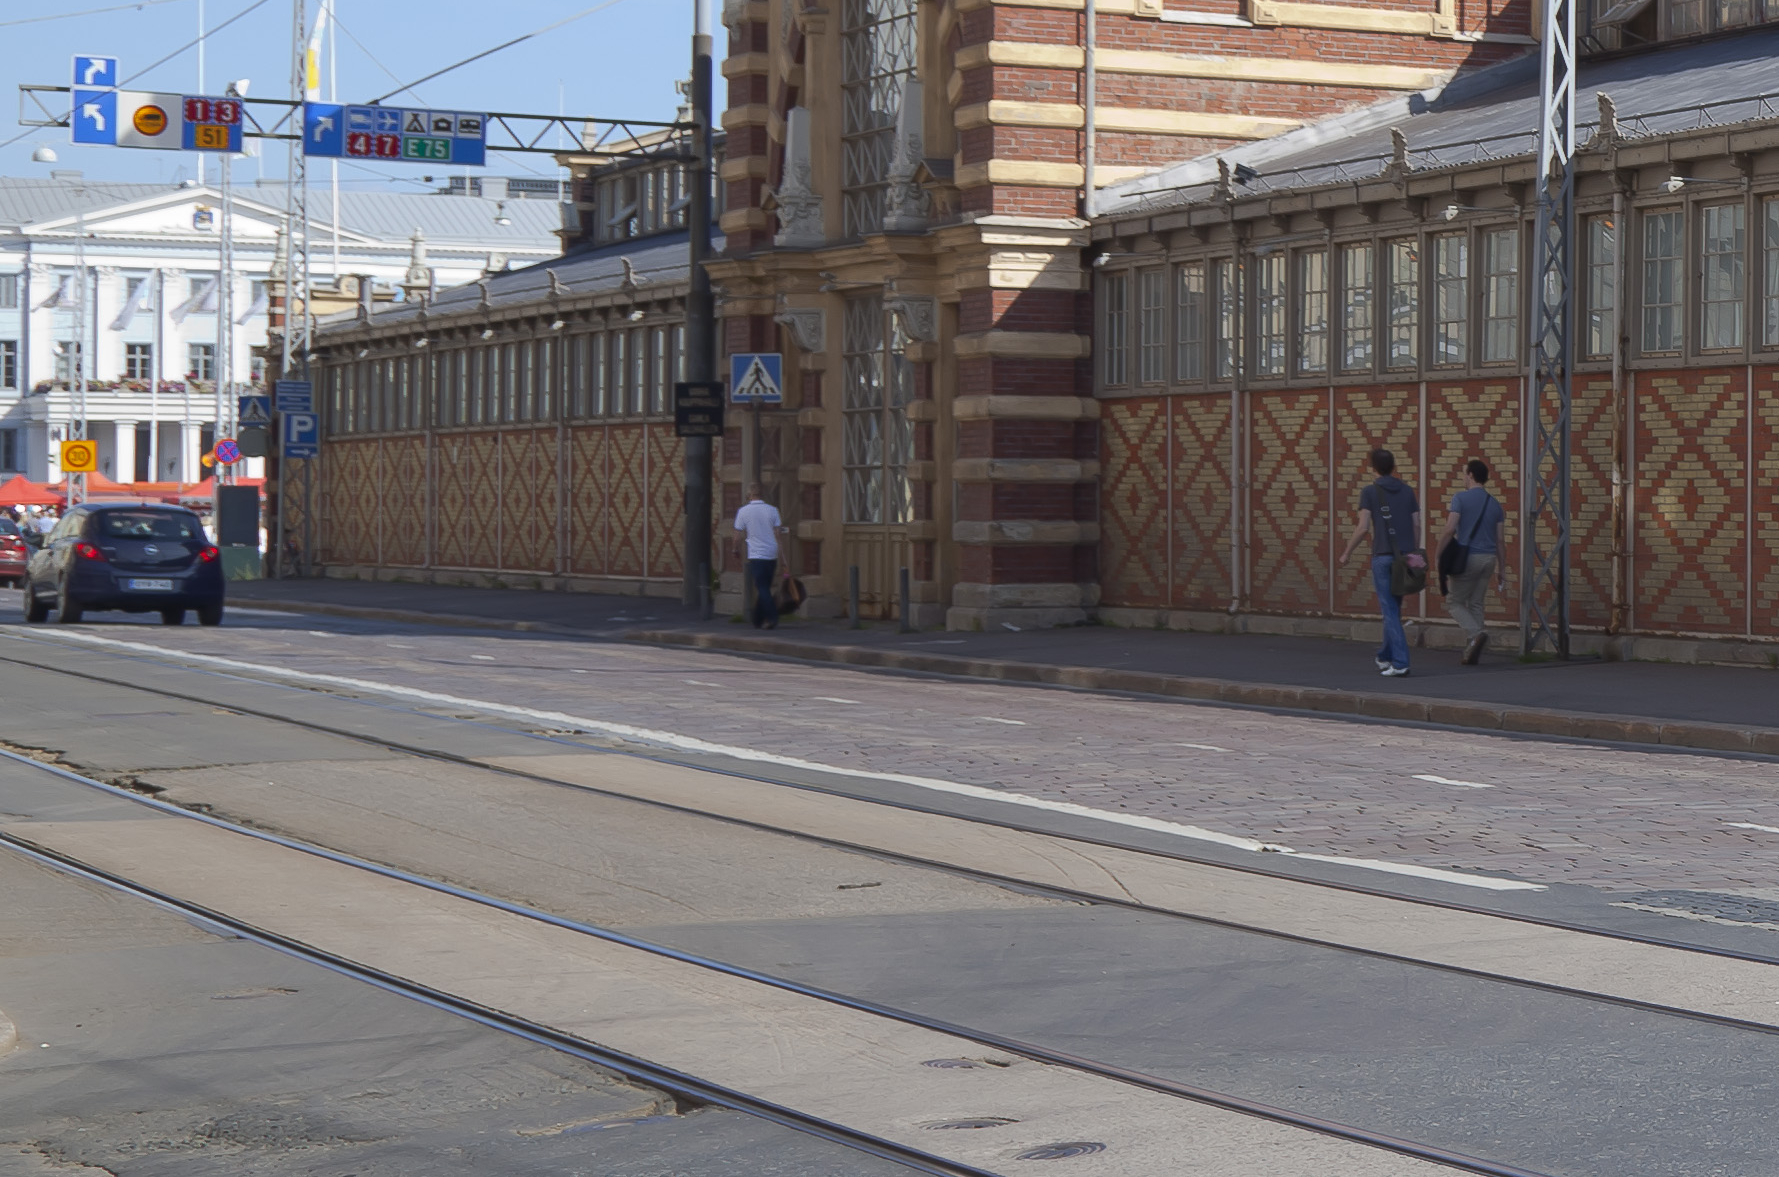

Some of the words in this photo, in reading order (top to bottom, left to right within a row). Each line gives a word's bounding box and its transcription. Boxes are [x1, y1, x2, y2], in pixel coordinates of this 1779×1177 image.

[195, 102, 203, 120] 1
[221, 103, 233, 121] 3
[203, 127, 221, 145] 51
[354, 137, 366, 153] 4
[382, 137, 393, 154] 7
[407, 139, 419, 156] E
[423, 139, 446, 158] 75
[290, 415, 314, 442] P
